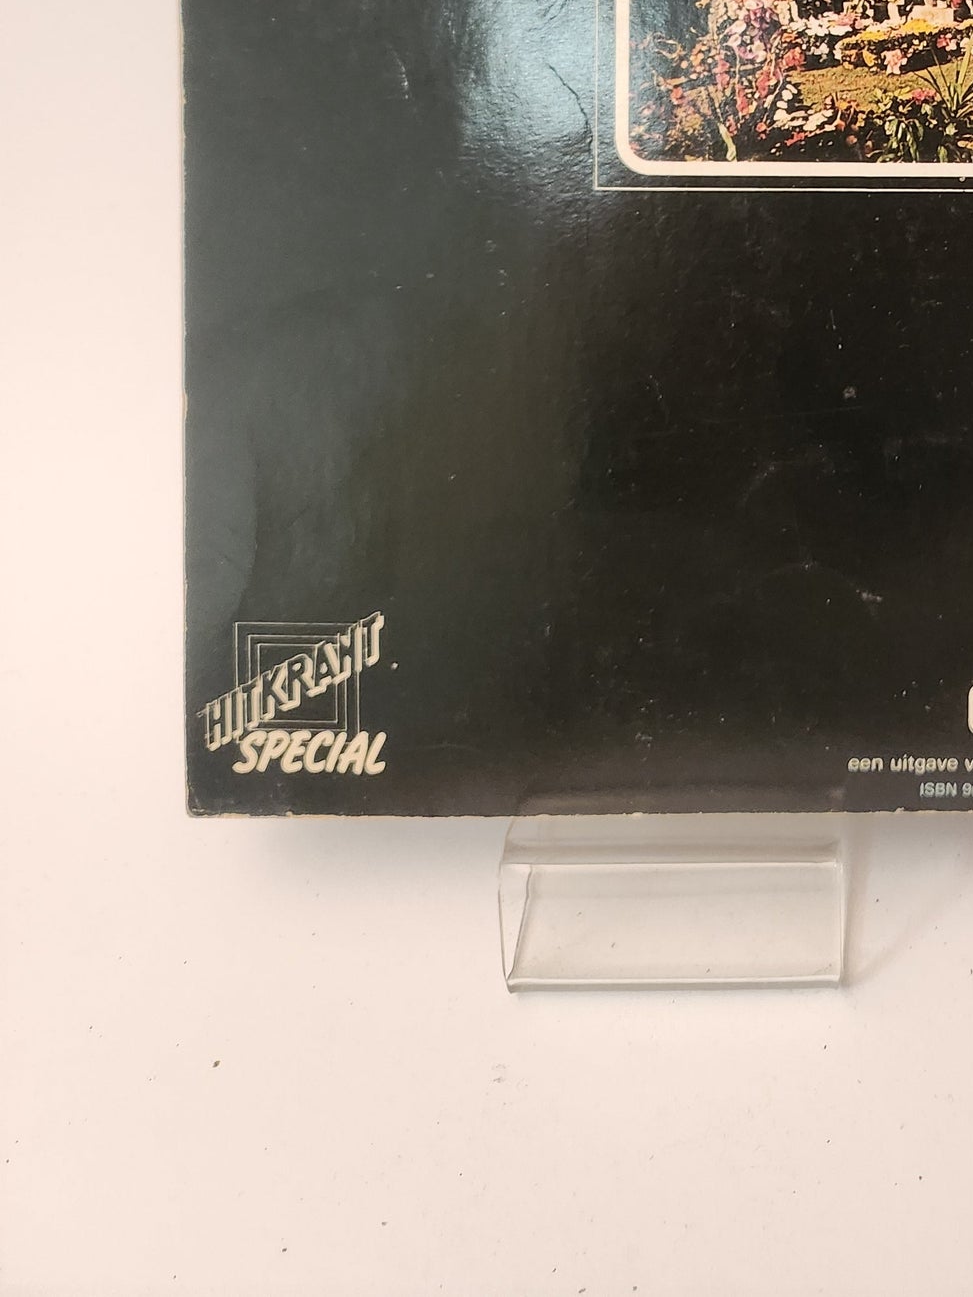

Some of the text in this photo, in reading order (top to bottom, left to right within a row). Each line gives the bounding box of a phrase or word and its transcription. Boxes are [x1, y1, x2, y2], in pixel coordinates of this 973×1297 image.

[232, 730, 387, 775] SPECIAL
[848, 755, 884, 772] een
[890, 753, 960, 775] uitgave
[919, 782, 957, 798] ISBN
